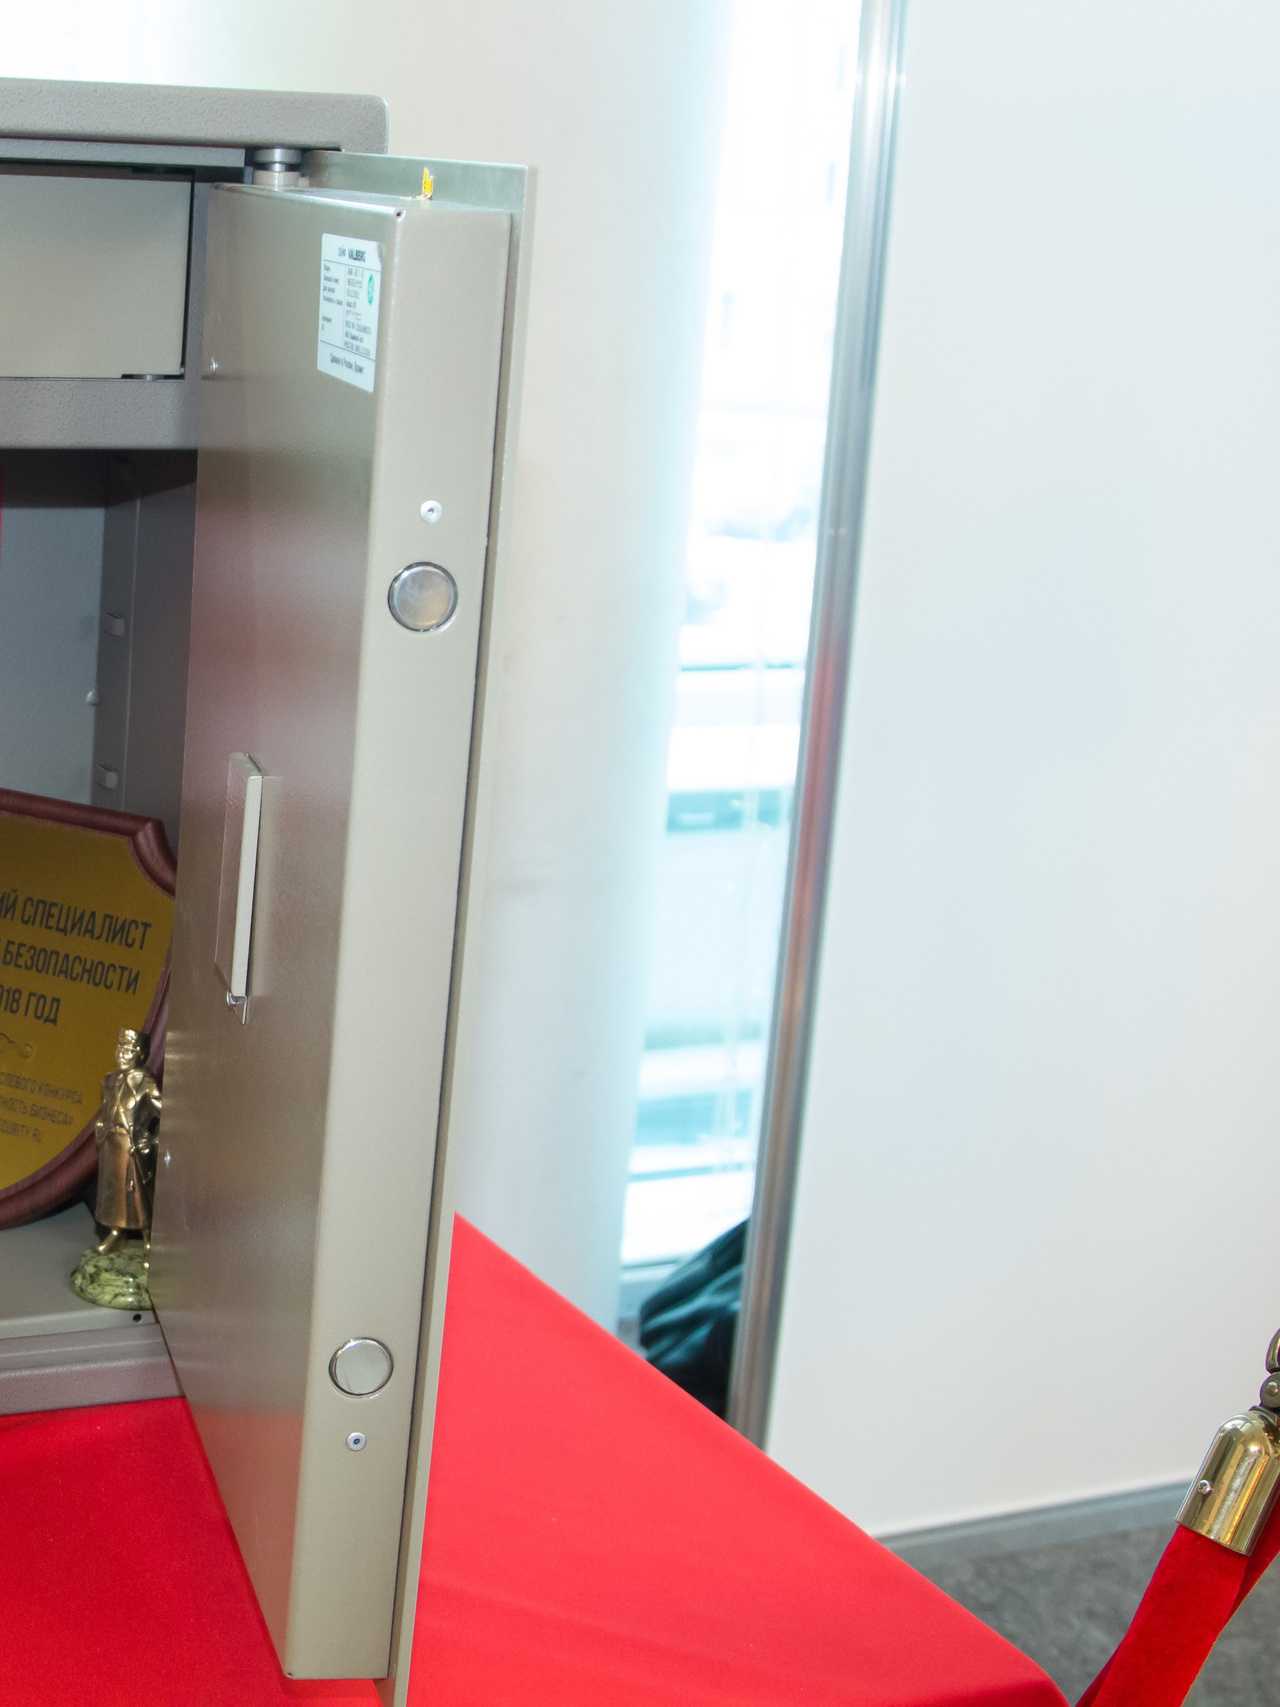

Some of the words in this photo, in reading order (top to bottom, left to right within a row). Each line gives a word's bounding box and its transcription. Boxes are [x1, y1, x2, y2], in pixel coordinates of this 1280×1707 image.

[20, 896, 152, 950] СПЕЦИАЛИСТ
[2, 939, 140, 995] БЕЗОПАСНОСТИ
[24, 991, 61, 1027] ГОД
